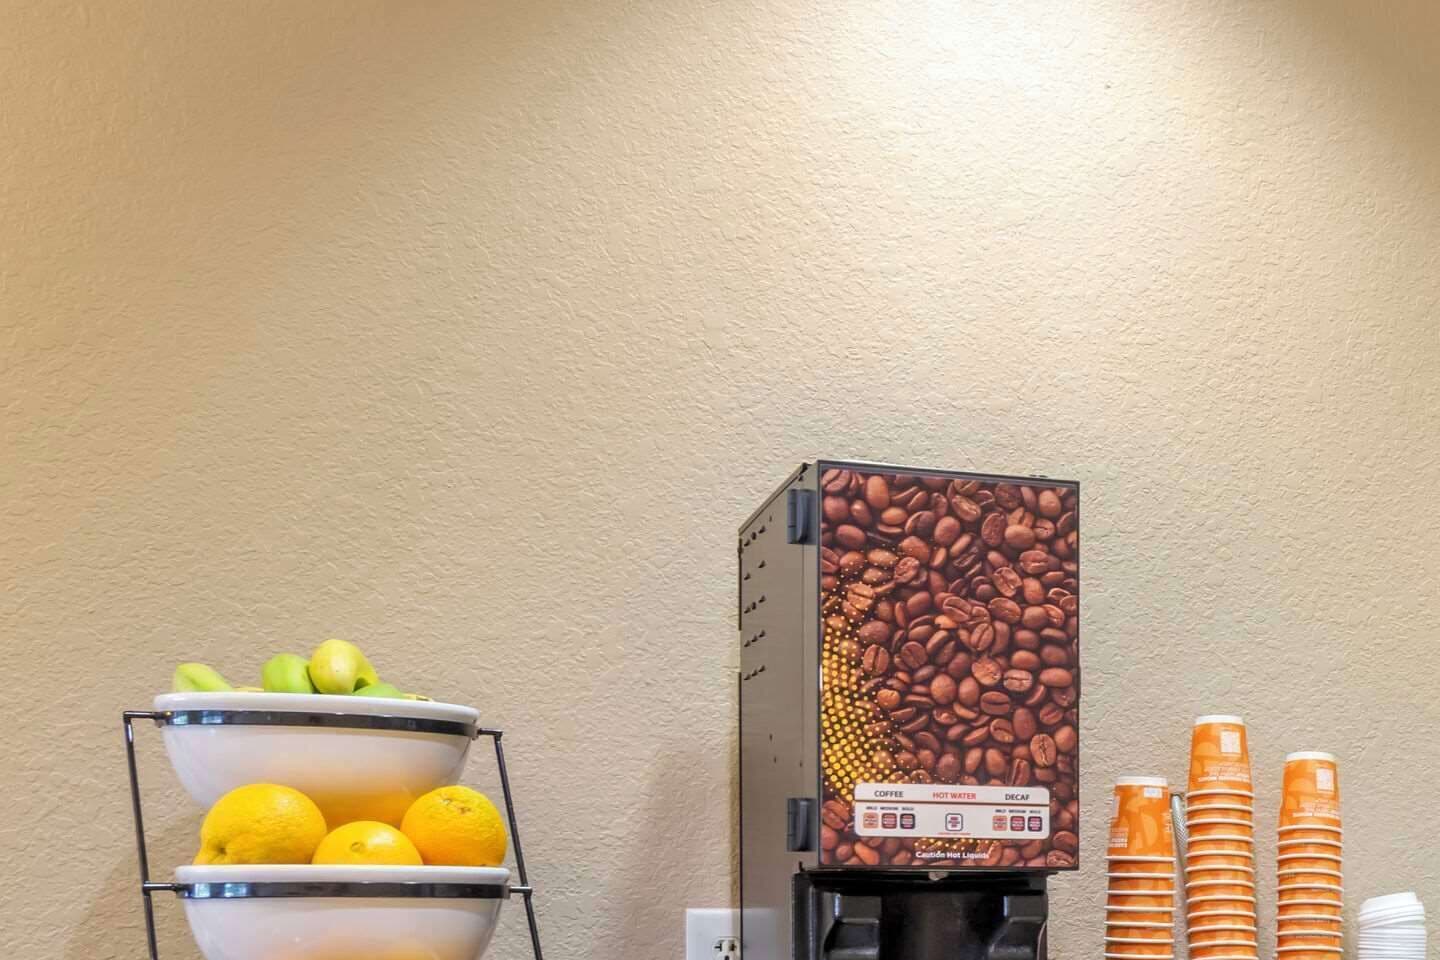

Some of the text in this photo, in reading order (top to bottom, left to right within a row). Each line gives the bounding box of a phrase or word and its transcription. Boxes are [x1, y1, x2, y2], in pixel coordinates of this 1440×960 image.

[874, 790, 904, 798] COFFEE
[932, 791, 976, 800] HOT WATER
[1005, 793, 1030, 801] DECAF
[915, 850, 990, 860] Caution Hot Liquids
